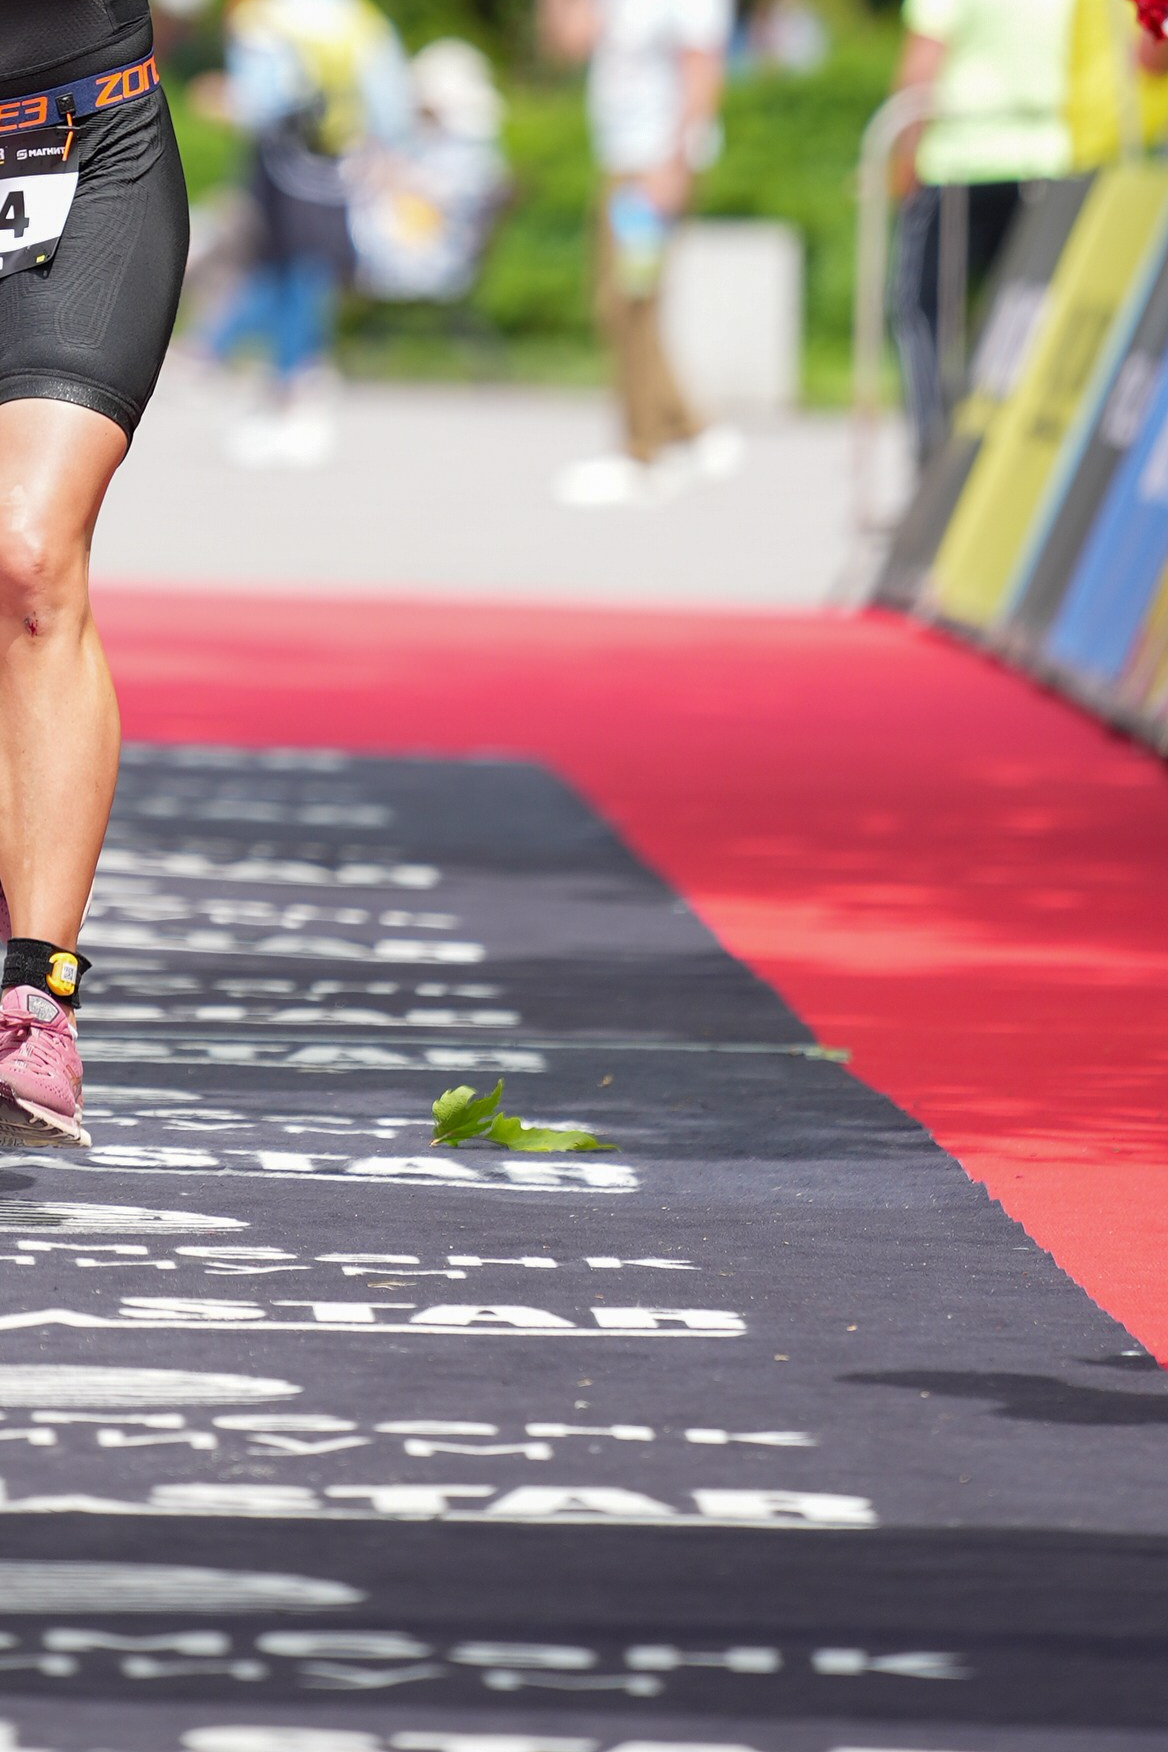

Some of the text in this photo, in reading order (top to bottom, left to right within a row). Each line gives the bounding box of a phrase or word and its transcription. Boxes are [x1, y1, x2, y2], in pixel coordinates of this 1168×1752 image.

[28, 146, 66, 157] МАГНИТ
[86, 1145, 639, 1188] STAR
[118, 1295, 748, 1330] STAR
[150, 1482, 880, 1525] STAR
